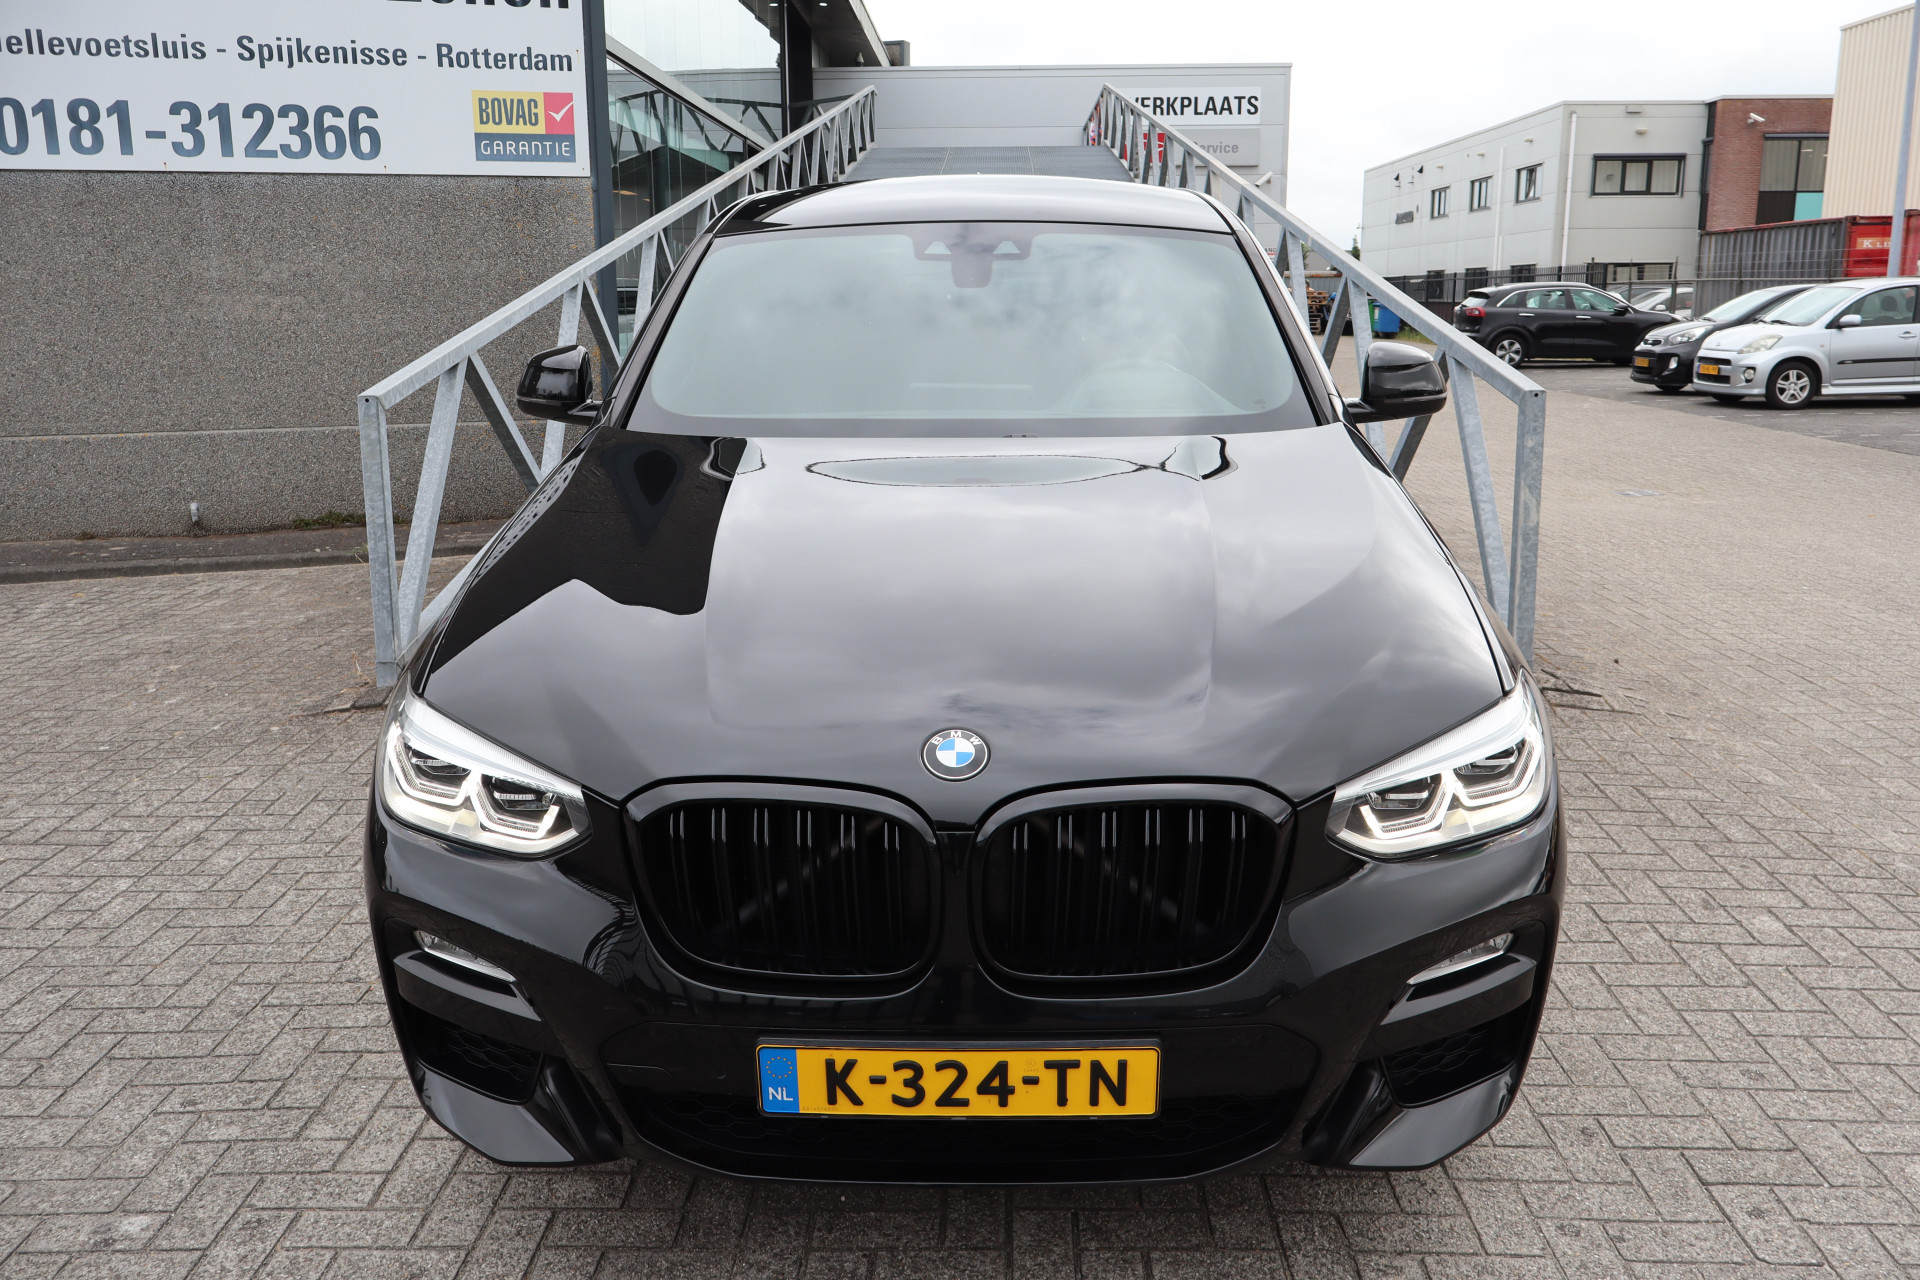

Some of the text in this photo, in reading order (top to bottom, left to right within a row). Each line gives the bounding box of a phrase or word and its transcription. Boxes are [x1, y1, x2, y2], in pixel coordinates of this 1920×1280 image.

[0, 28, 207, 60] ellevoetsluis
[237, 35, 407, 69] Spijkenisse
[436, 43, 573, 72] Rotterdam
[478, 97, 539, 126] BOVAG
[0, 97, 382, 161] 0181-312366
[480, 140, 571, 156] GARANTIE
[930, 731, 981, 746] BMW
[768, 1086, 794, 1102] NL
[825, 1058, 1128, 1108] K-324-TN
